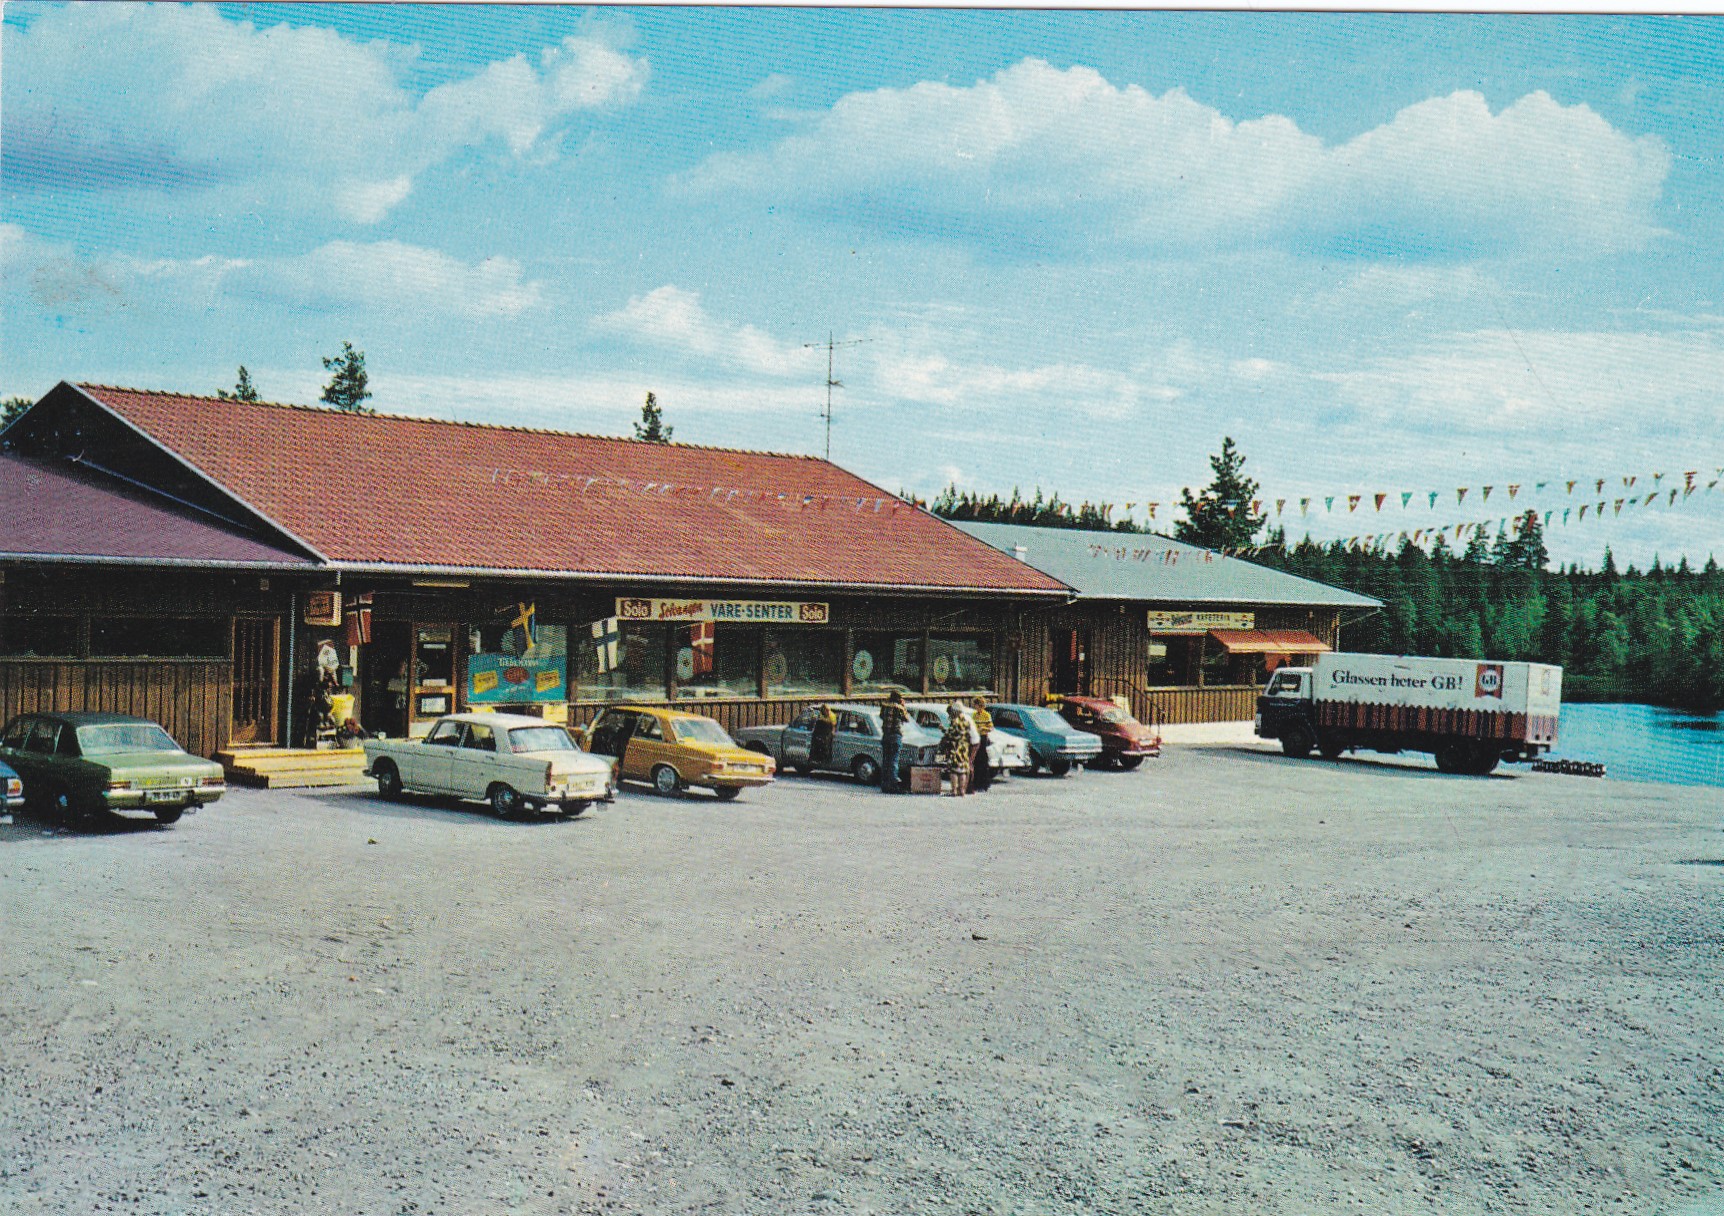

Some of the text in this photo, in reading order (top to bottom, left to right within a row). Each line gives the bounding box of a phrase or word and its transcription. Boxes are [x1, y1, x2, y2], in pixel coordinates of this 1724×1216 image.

[623, 600, 649, 617] Solo
[710, 602, 793, 619] VARE-SENTER
[801, 604, 825, 620] Solo
[1332, 669, 1463, 690] Glassen heter GB!
[1481, 674, 1497, 686] GB
